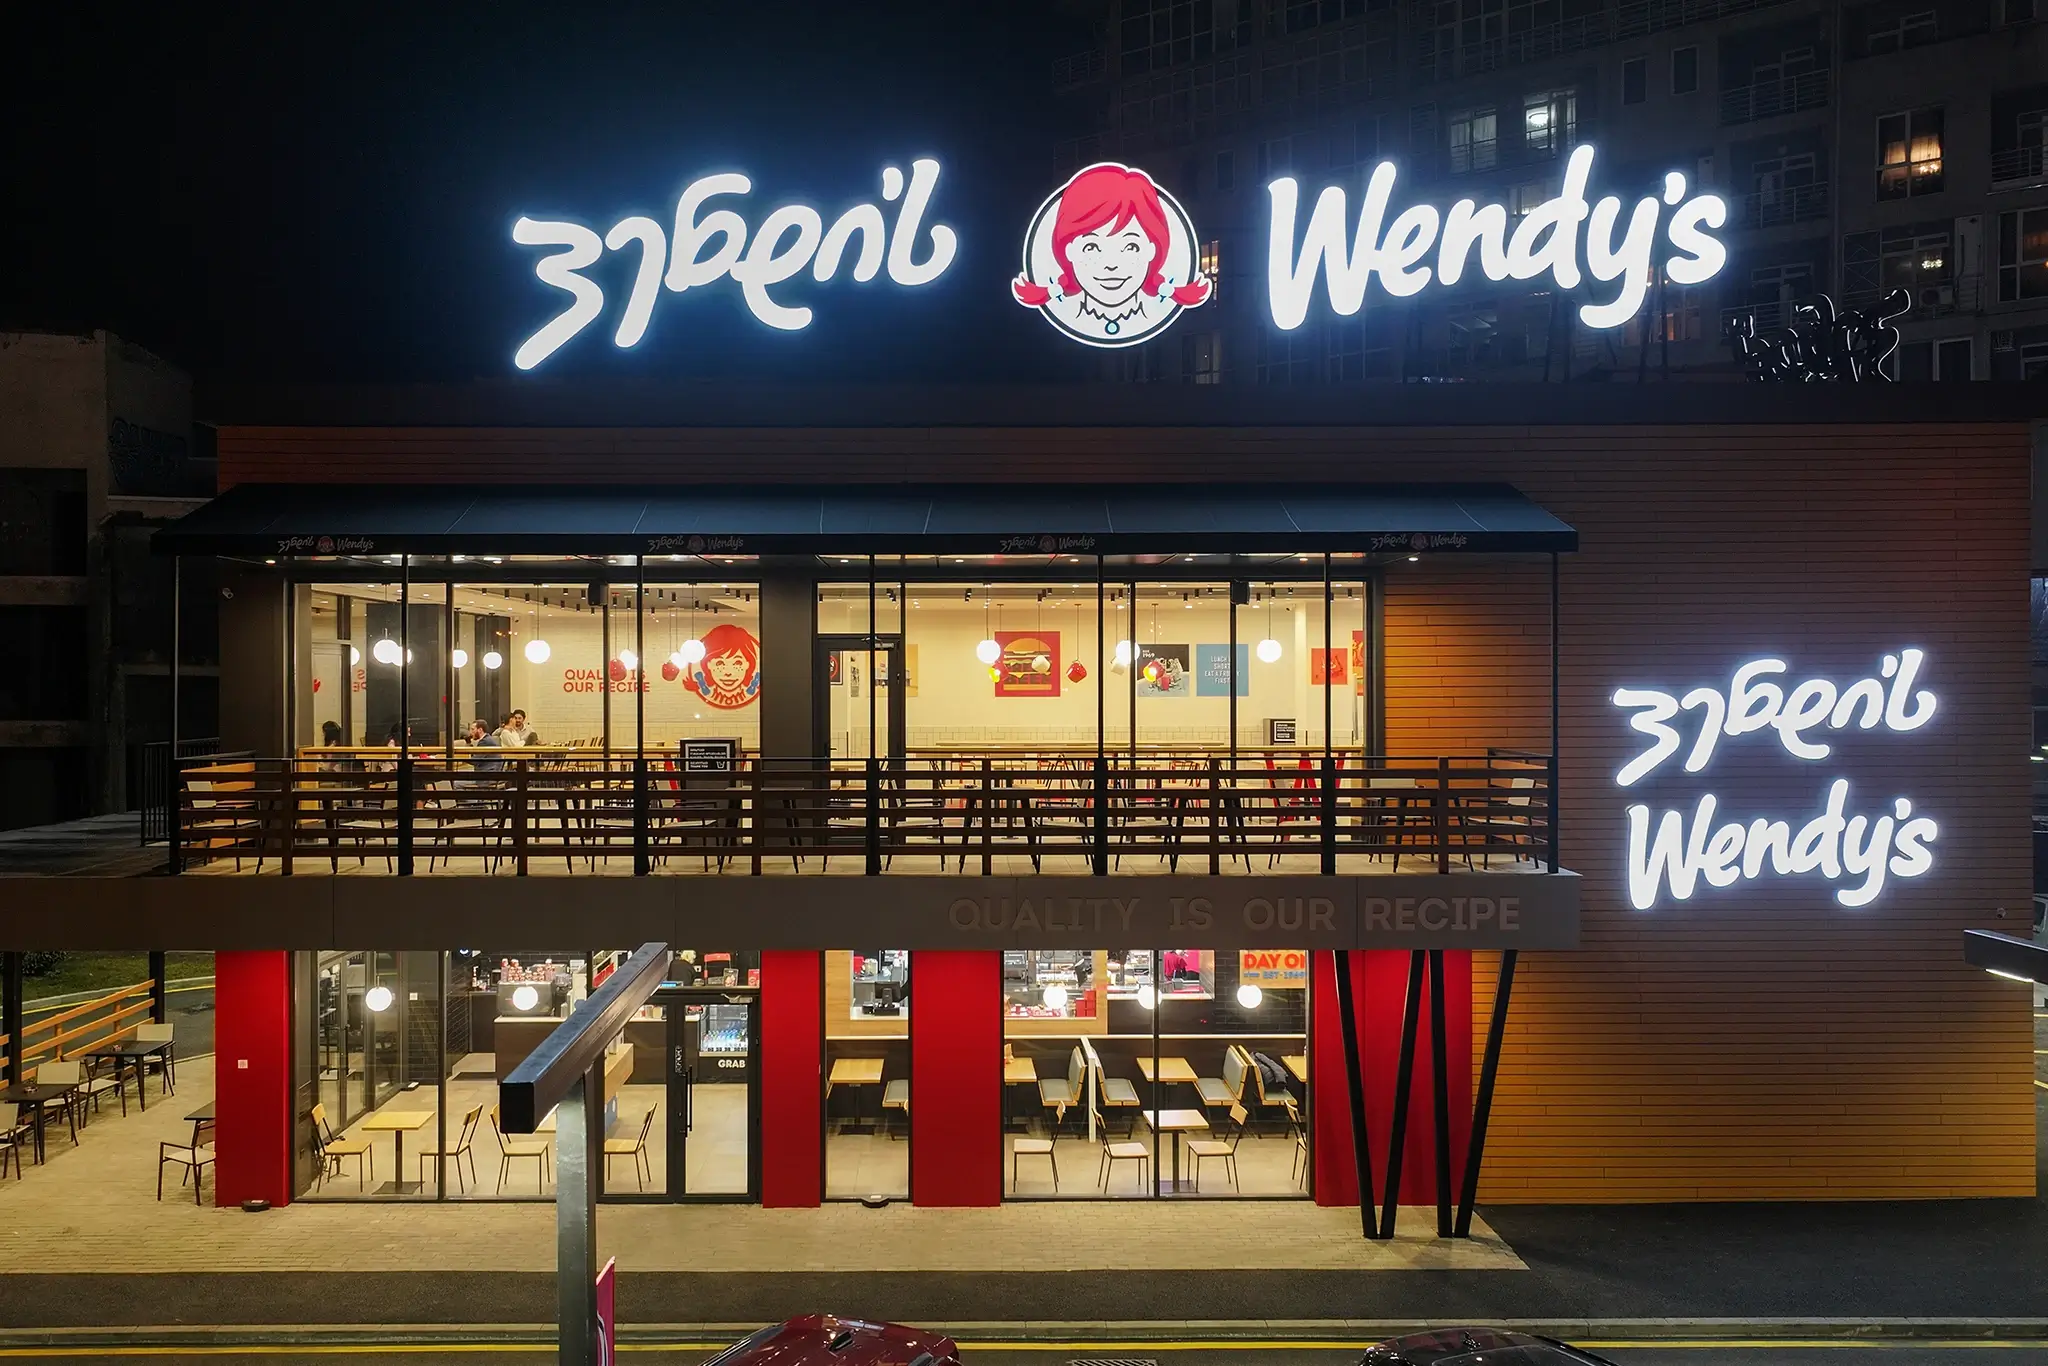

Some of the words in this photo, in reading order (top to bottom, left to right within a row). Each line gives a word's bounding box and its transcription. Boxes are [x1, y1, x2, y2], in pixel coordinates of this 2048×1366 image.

[1268, 144, 1728, 330] Wendy's
[337, 537, 374, 552] Wendy's
[707, 536, 744, 550] Wendy's
[1058, 536, 1095, 550] Wendy's
[1430, 533, 1468, 548] Wendy's
[563, 682, 594, 692] OUR
[1628, 778, 1938, 910] Wendy's
[947, 895, 1141, 932] QUALITY
[1168, 896, 1214, 932] IS
[1242, 896, 1337, 931] OUR
[1365, 897, 1521, 931] RECIPE
[1244, 953, 1281, 969] DAY
[718, 1059, 746, 1068] GRAB
